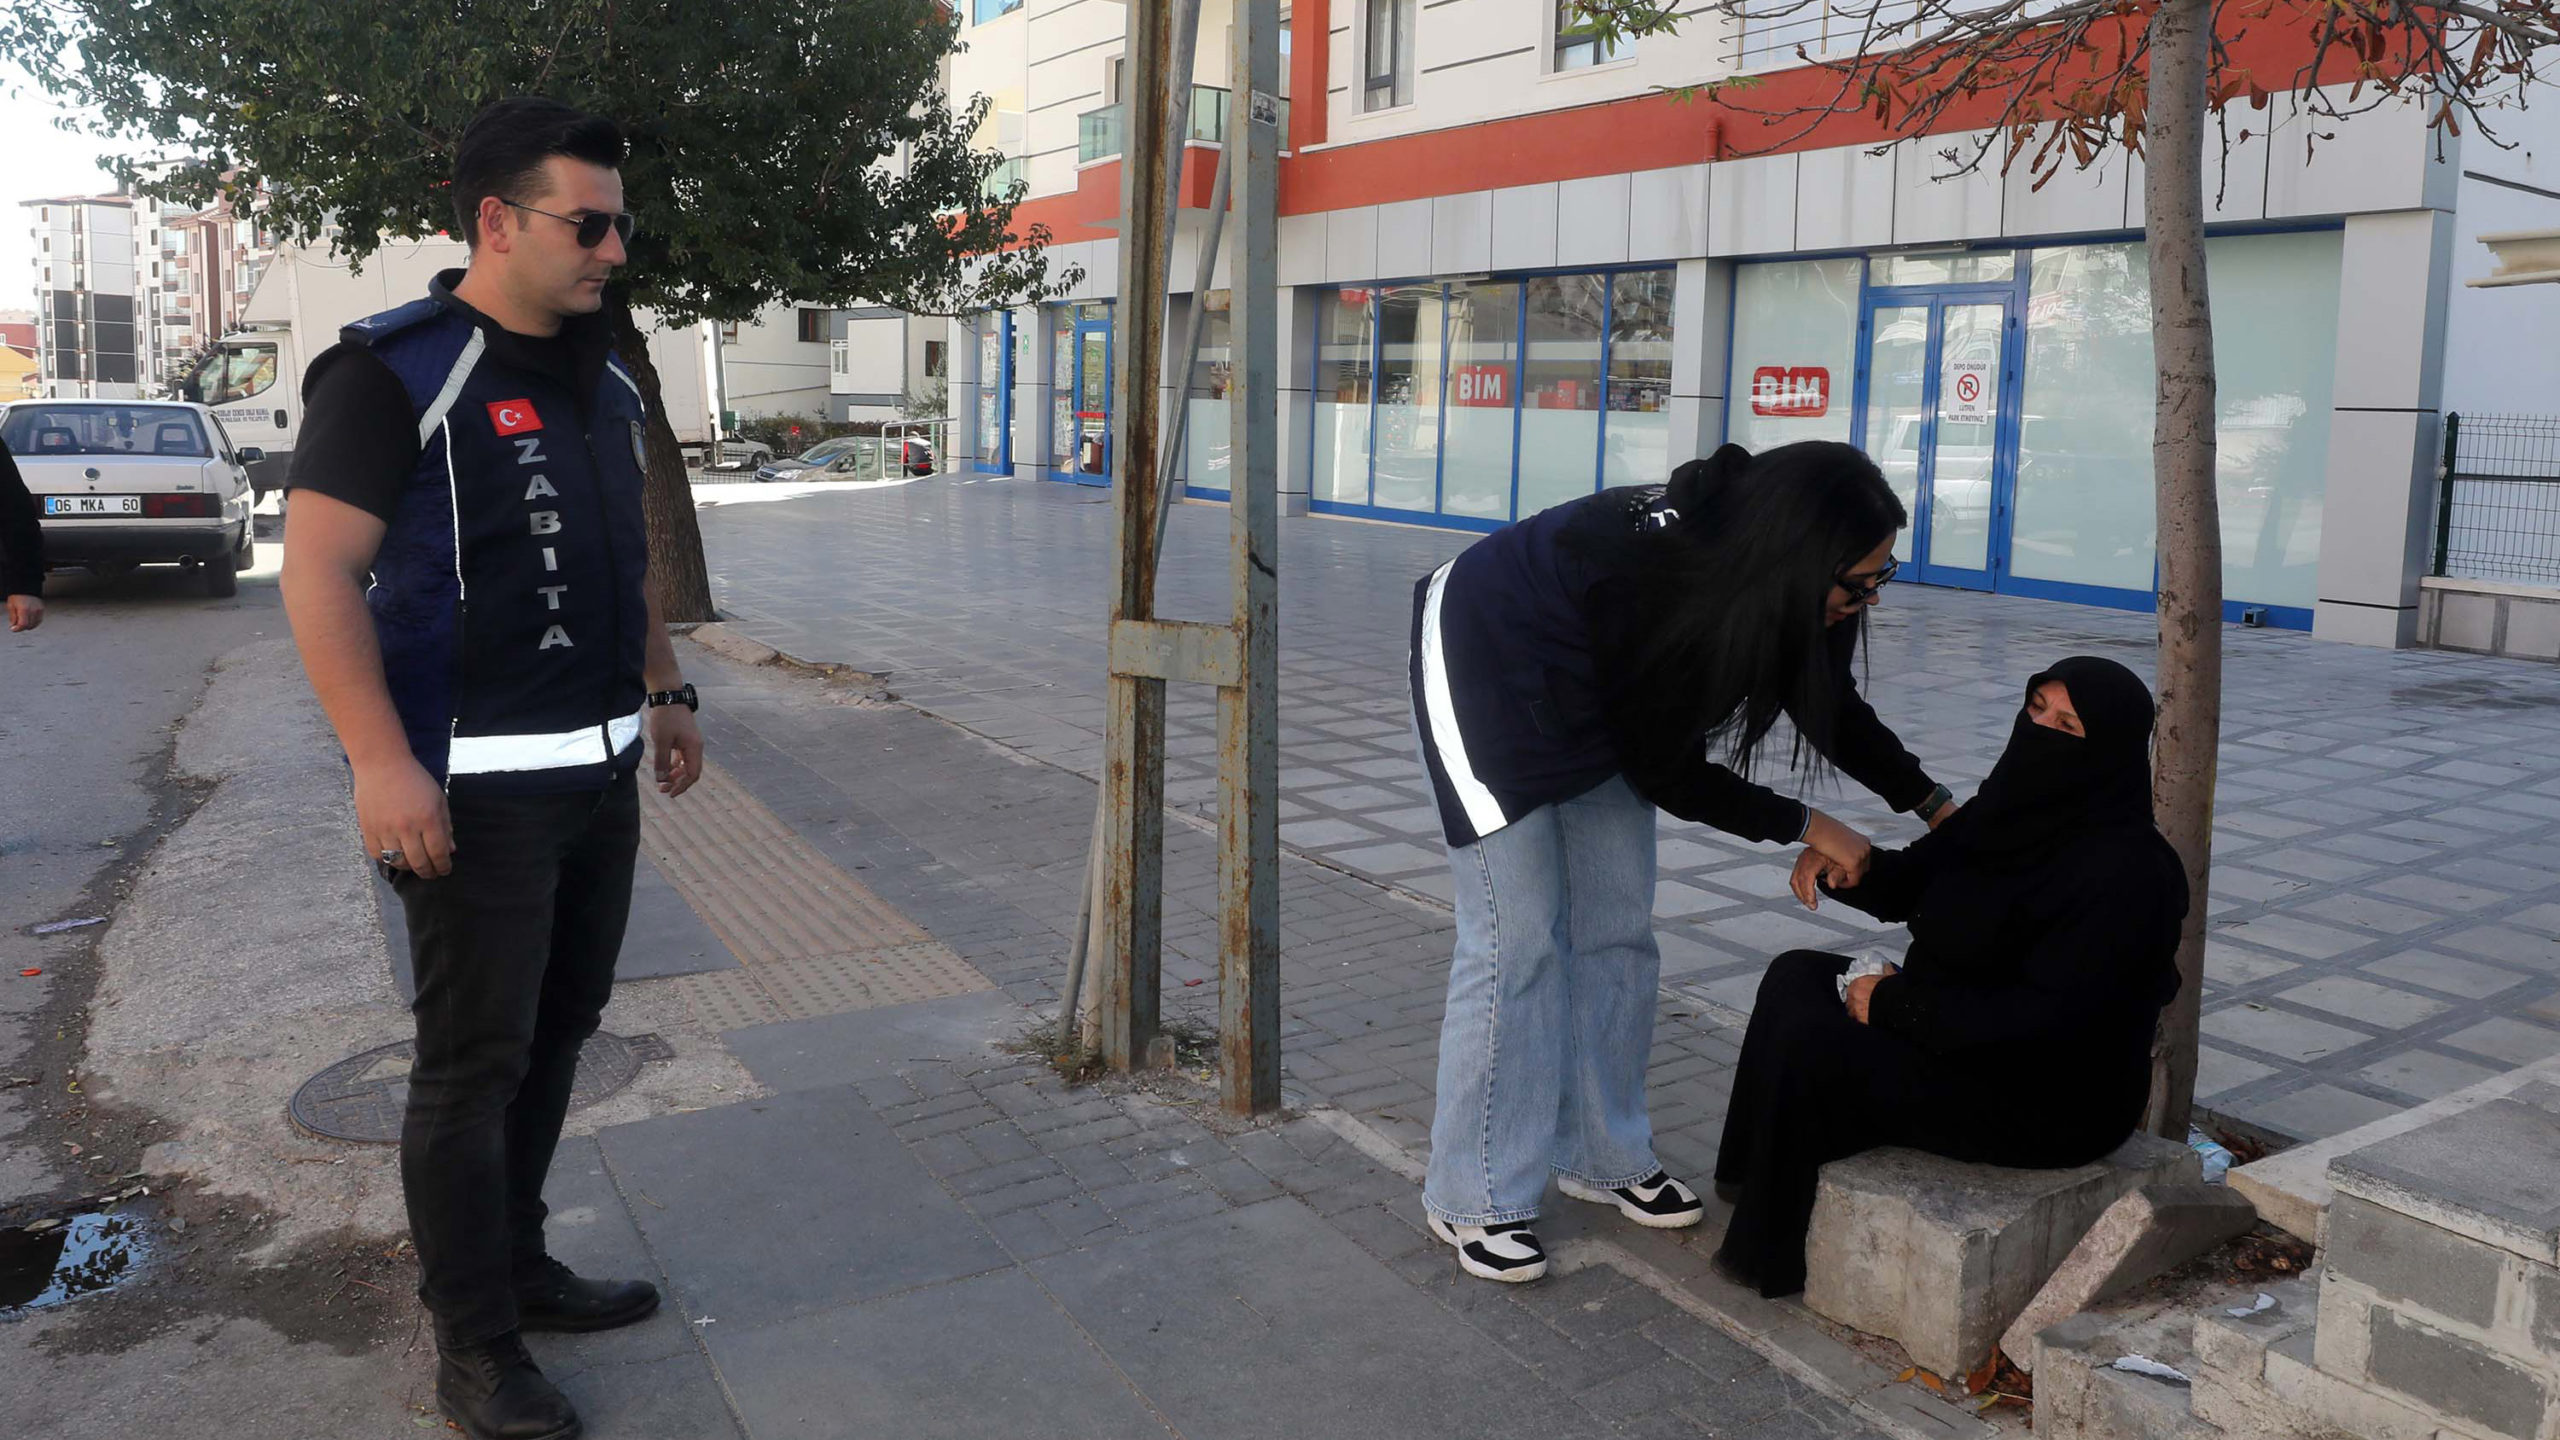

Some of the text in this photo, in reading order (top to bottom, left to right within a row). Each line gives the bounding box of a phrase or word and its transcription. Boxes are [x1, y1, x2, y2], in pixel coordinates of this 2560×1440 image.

[55, 499, 71, 512] 06
[81, 499, 105, 511] MKA
[122, 498, 138, 511] 60
[514, 438, 574, 650] ZABITA
